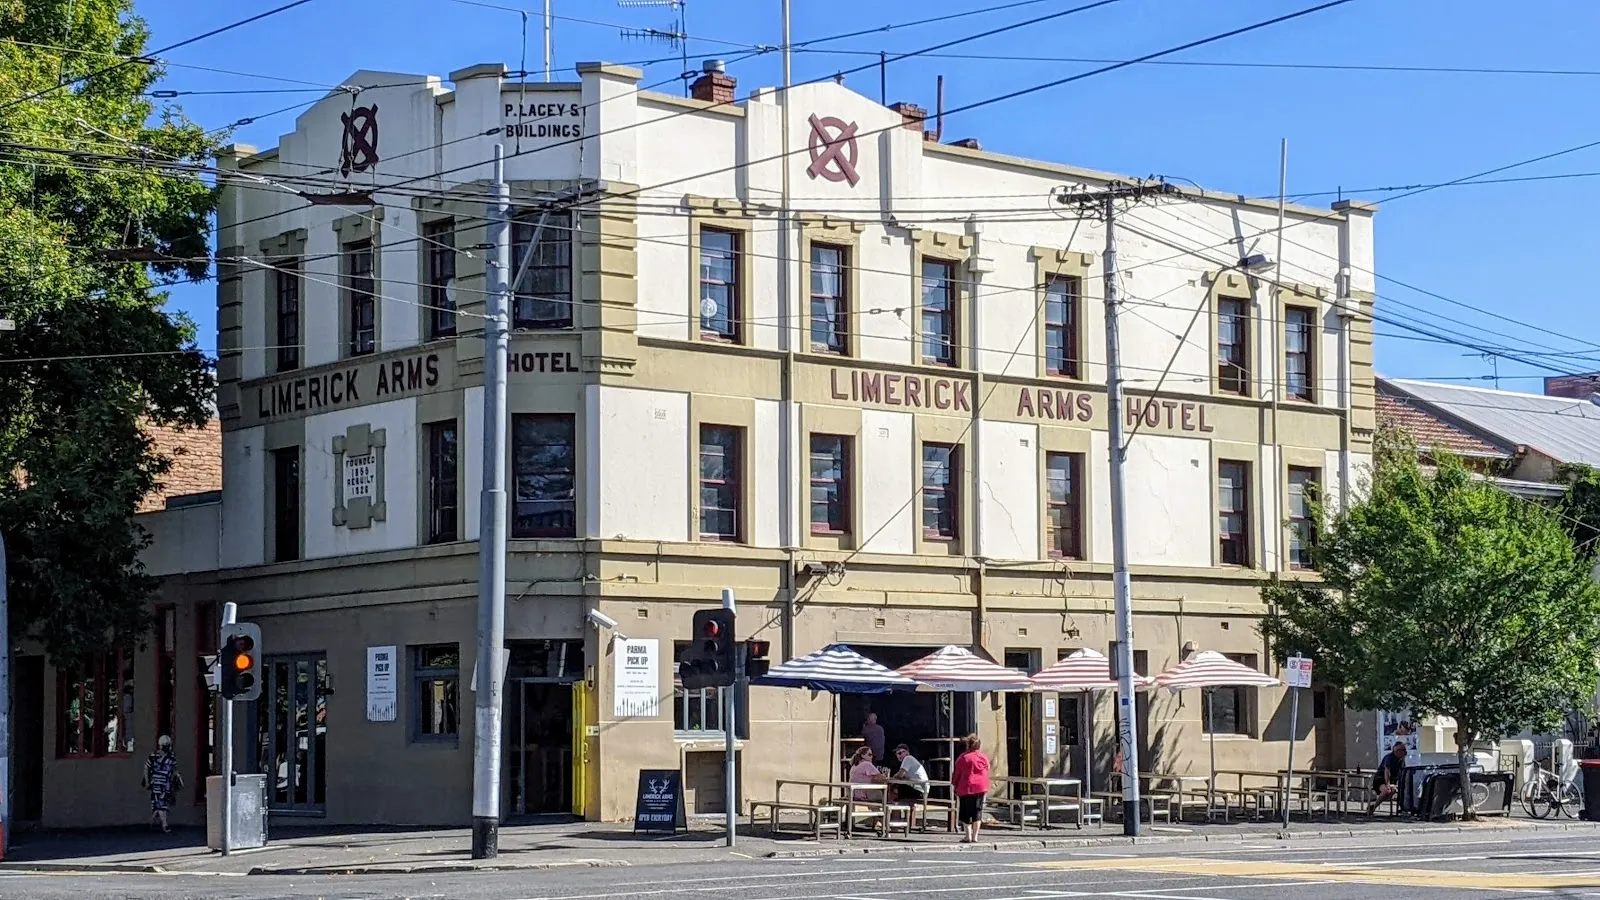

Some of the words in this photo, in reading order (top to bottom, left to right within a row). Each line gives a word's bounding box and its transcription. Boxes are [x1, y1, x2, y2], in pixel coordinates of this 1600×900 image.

[506, 124, 580, 138] BUILDINGS
[507, 352, 579, 372] HOTEL
[258, 369, 359, 418] LIMERICK
[376, 354, 439, 397] ARMS
[831, 368, 971, 411] LIMERICK
[1017, 387, 1093, 422] ARMS
[1126, 396, 1214, 433] HOTEL
[346, 456, 375, 468] FOUNDED
[347, 475, 374, 485] REBUILT
[626, 645, 647, 654] PARMA
[626, 656, 639, 665] PICK
[641, 656, 648, 665] UP
